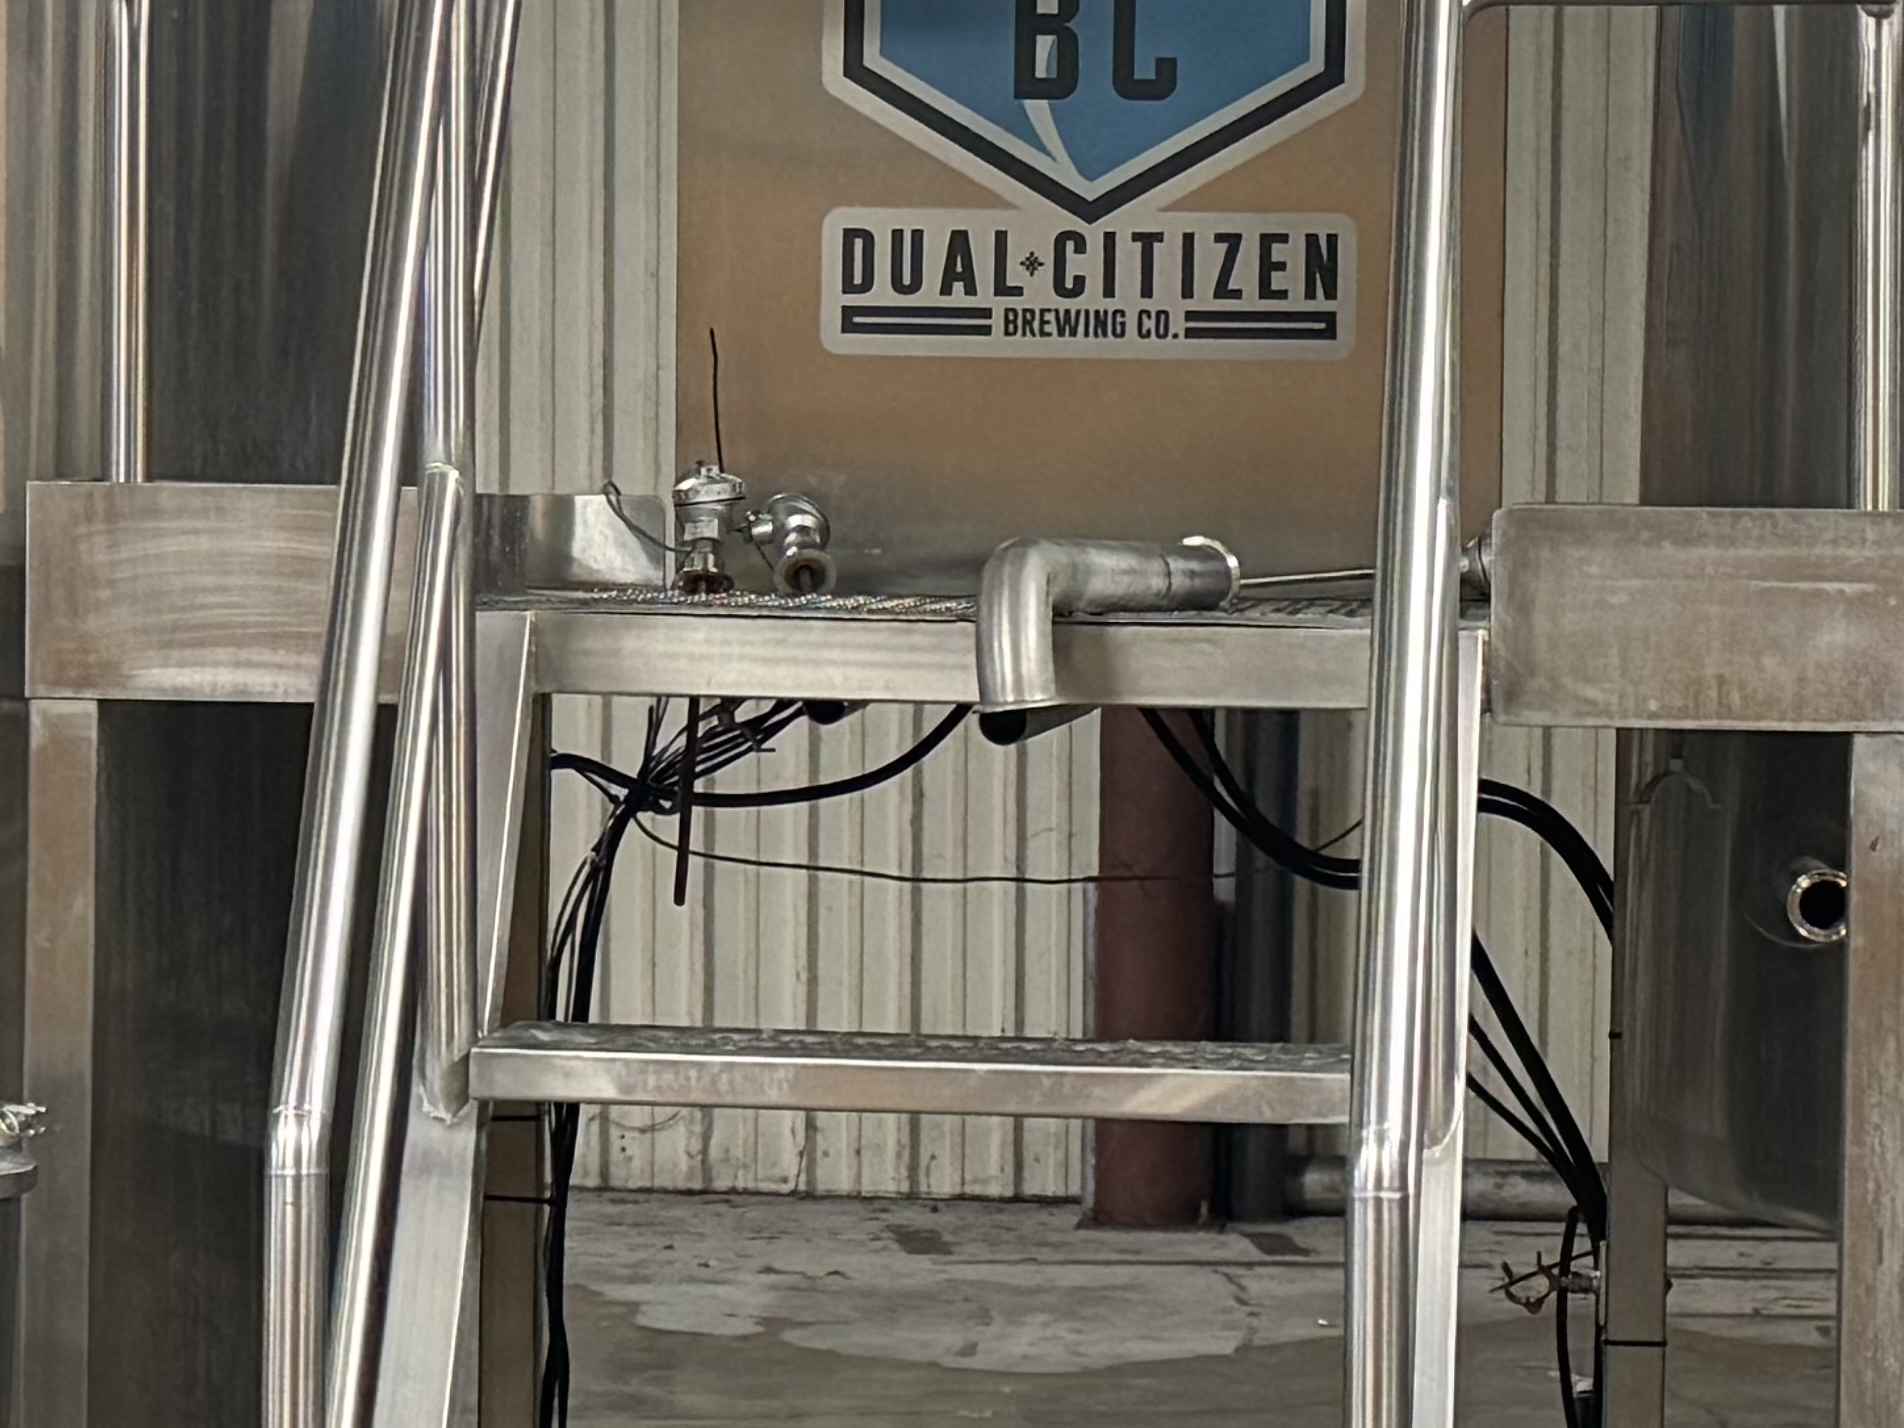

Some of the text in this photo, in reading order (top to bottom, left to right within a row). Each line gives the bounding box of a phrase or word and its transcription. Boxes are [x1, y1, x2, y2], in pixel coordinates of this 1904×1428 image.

[840, 226, 1339, 302] DUAL CITIZEN
[1002, 307, 1181, 341] BREWING CO.
